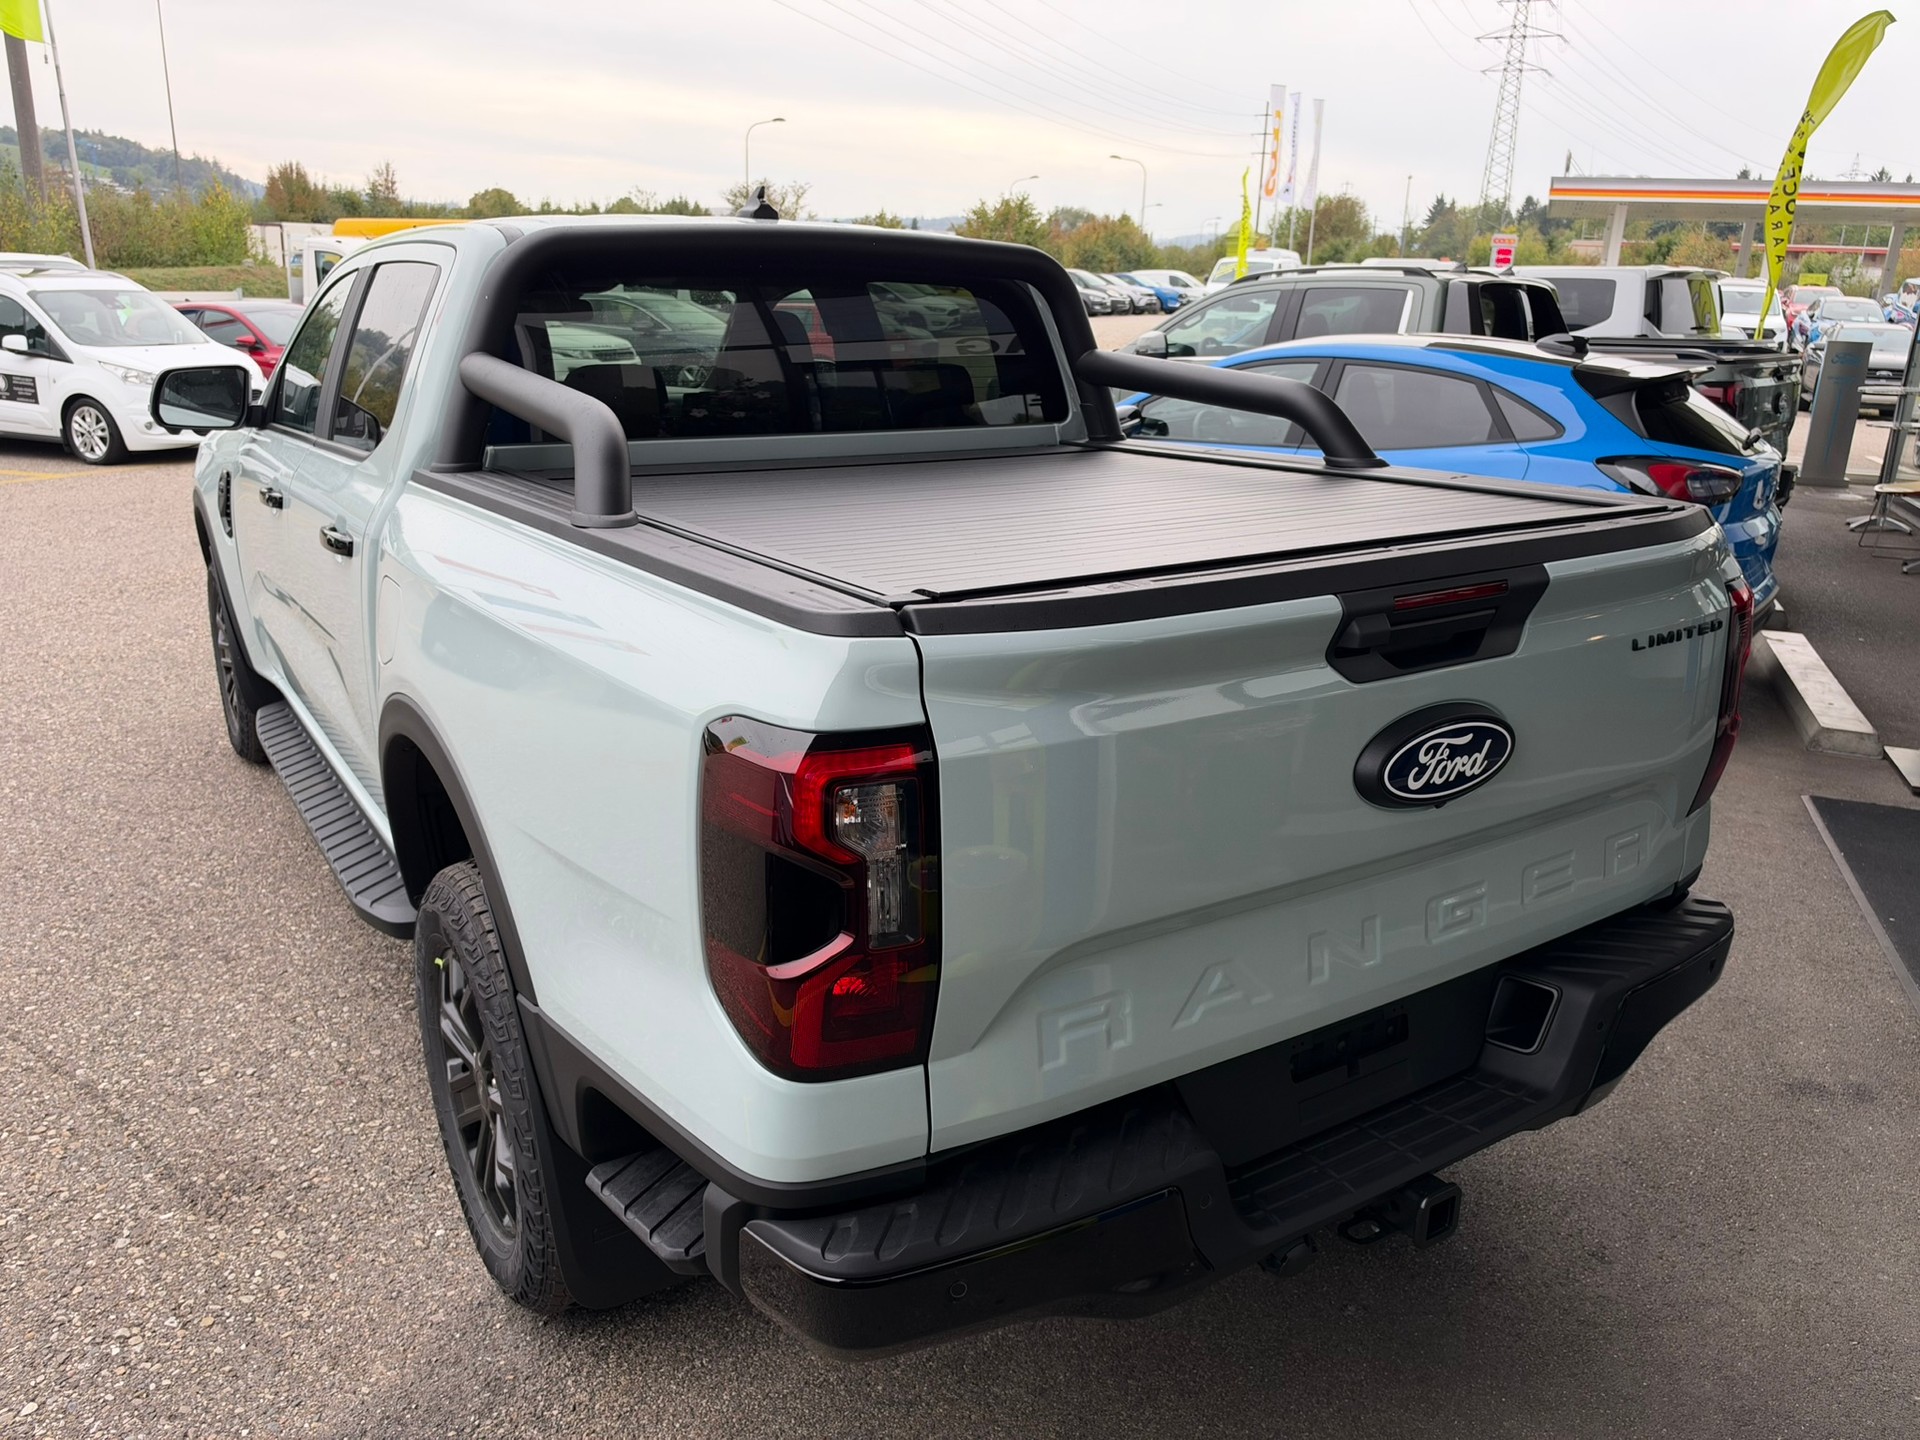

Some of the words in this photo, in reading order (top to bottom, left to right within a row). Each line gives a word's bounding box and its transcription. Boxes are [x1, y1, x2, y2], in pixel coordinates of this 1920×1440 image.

[1632, 620, 1723, 651] LIMITED
[1407, 733, 1492, 790] Ford
[1038, 827, 1648, 1070] RANGER
